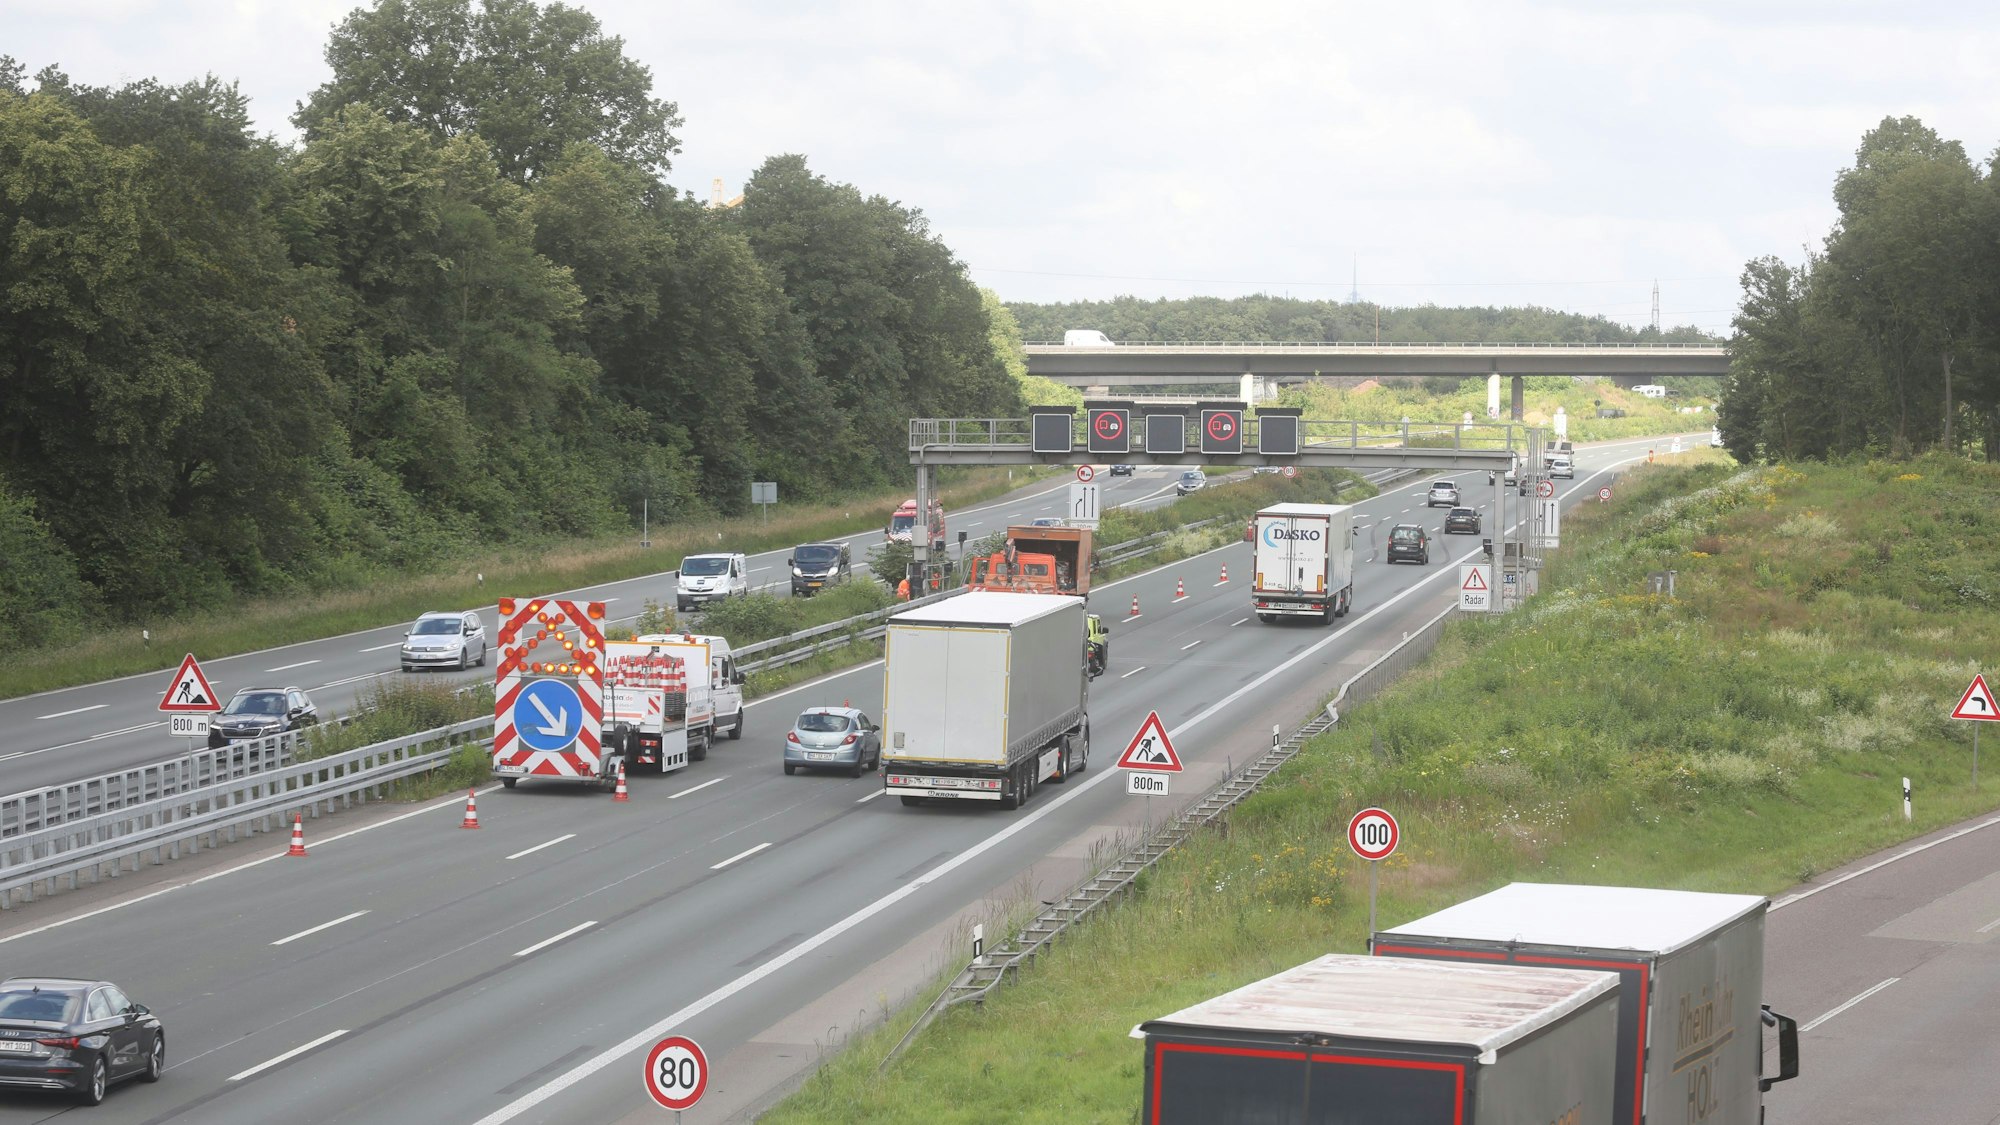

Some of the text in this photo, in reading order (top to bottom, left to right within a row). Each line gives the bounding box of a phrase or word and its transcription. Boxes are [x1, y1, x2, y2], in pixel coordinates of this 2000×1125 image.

[1274, 528, 1320, 541] DASKO
[1464, 594, 1484, 605] Radar
[173, 718, 207, 732] 800 m
[1133, 776, 1163, 791] 800m
[1359, 823, 1388, 846] 100
[660, 1057, 695, 1089] 80
